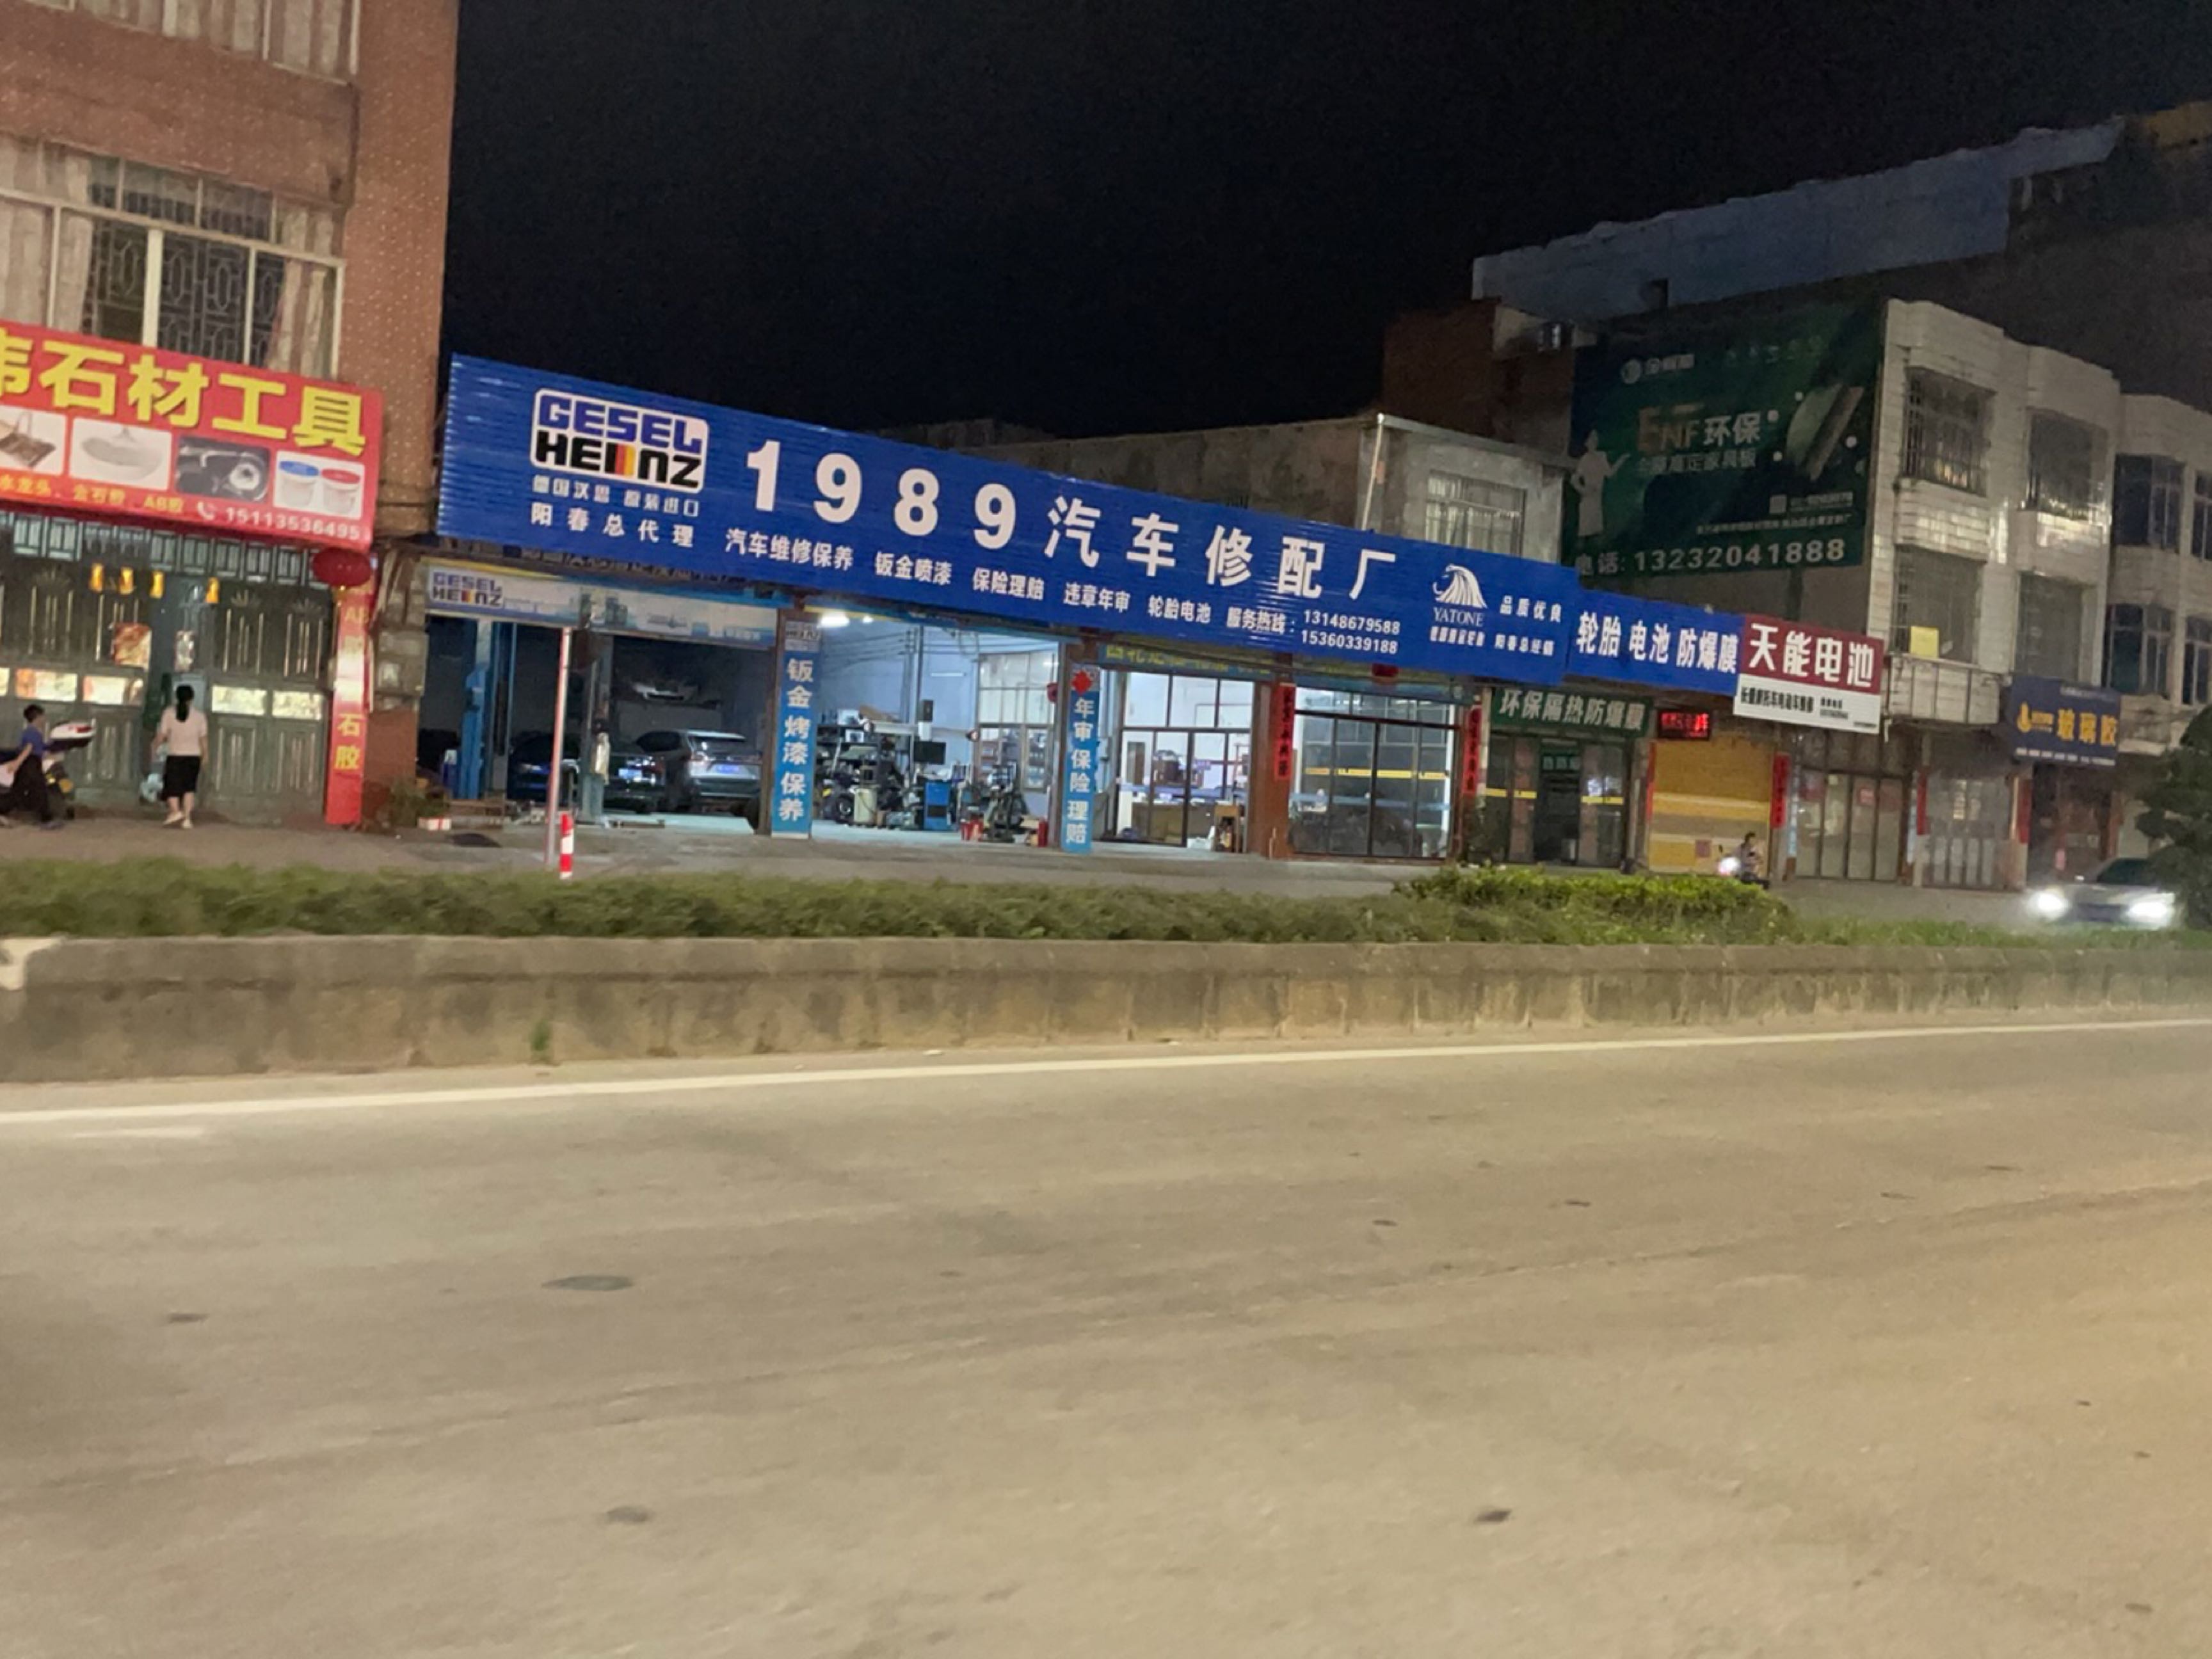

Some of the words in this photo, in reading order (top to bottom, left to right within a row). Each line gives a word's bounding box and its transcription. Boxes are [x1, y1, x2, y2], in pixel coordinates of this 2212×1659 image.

[539, 394, 702, 454] GESEL
[531, 502, 694, 549] 阳春总代理
[725, 528, 854, 572] 汽车维修保养
[874, 551, 952, 586] 钣金喷漆
[972, 567, 1045, 602] 保险理赔
[1063, 581, 1131, 614] 违章年审
[1148, 594, 1212, 625] 轮胎电池
[1634, 538, 1845, 572] 13232041888
[1304, 609, 1401, 636] 13148679588
[1433, 606, 1485, 628] YATONE
[1575, 611, 1623, 658] 轮胎
[1628, 620, 1669, 664] 电池
[1301, 629, 1399, 655] 15360339188
[1749, 622, 1875, 688] 天能电池
[1498, 687, 1646, 731] 环保隔热防爆膜
[1066, 698, 1095, 845] 年审保险理赔
